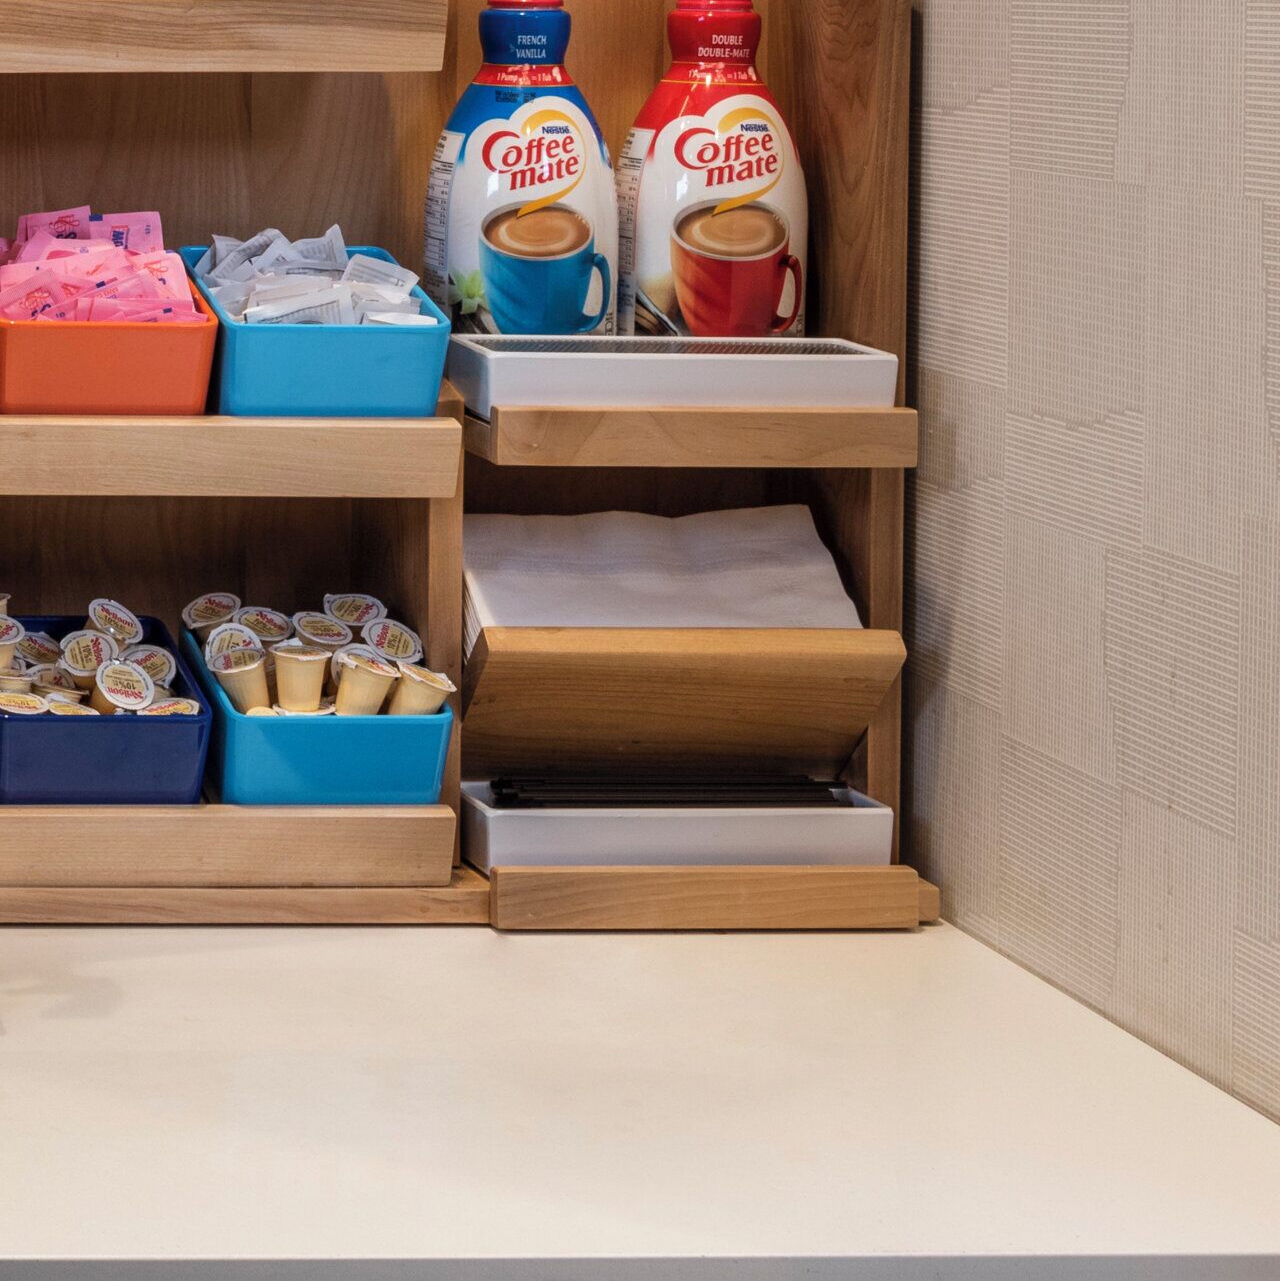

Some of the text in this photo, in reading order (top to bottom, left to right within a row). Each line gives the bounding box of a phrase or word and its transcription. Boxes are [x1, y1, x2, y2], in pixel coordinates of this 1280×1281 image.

[517, 35, 547, 45] FRENCH
[712, 34, 743, 45] DOUBLE
[516, 48, 546, 58] VANILLA
[698, 47, 750, 58] DOUBLE-MATE
[482, 130, 575, 174] Coffee
[674, 127, 774, 170] Coffee
[509, 156, 579, 190] mate
[705, 154, 778, 187] mate
